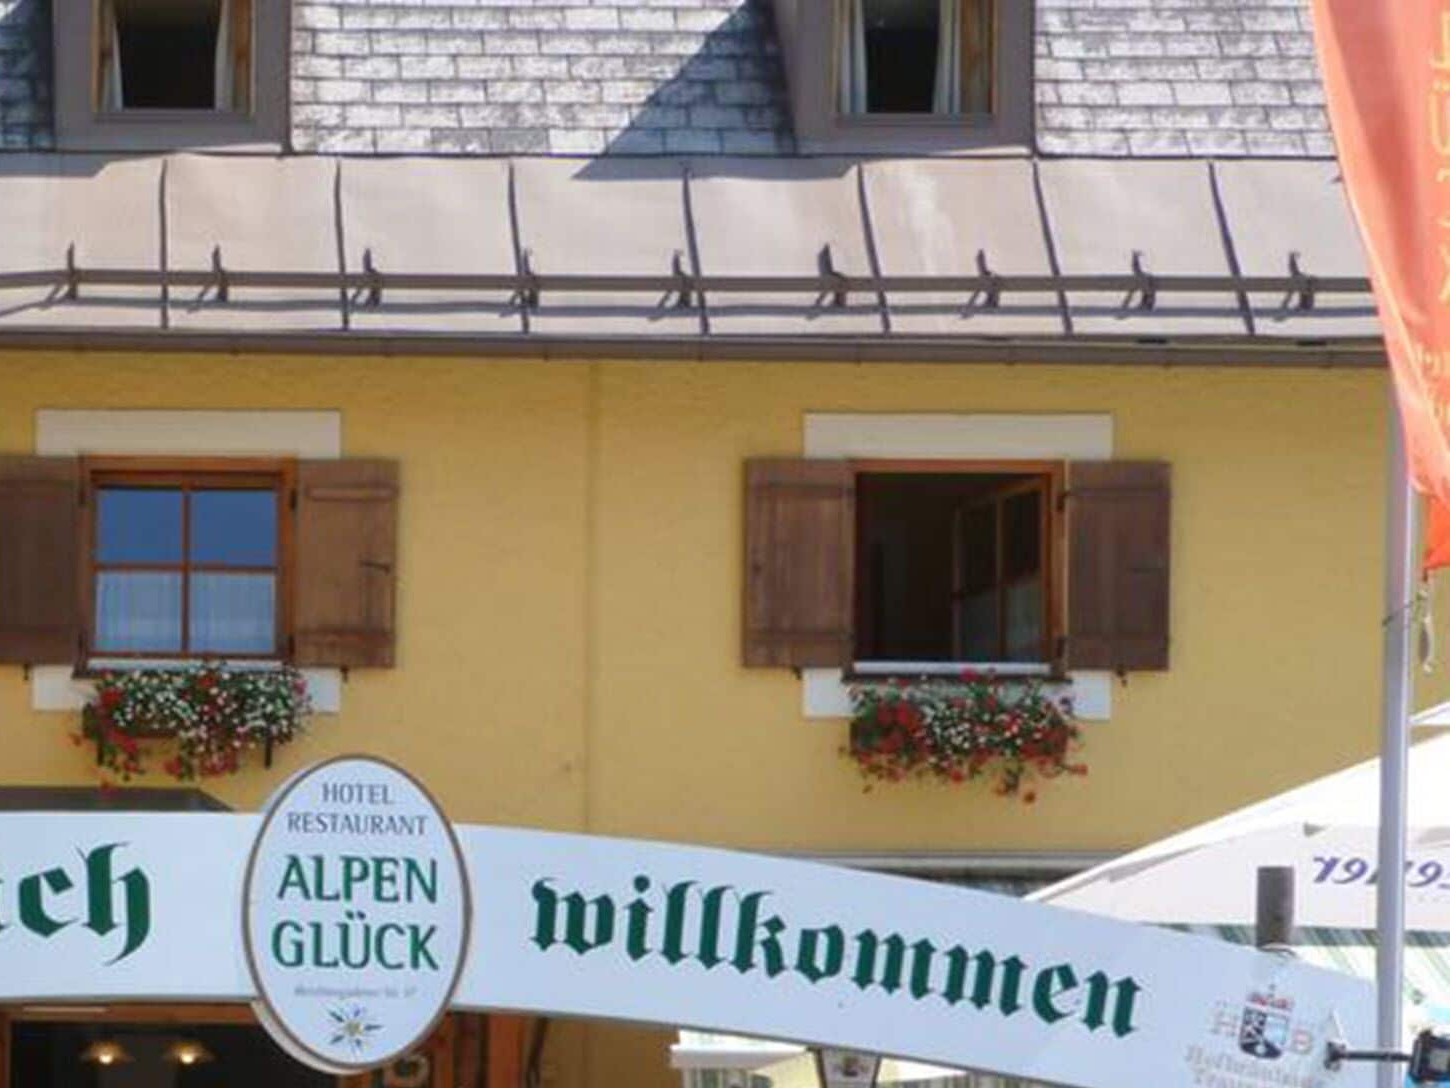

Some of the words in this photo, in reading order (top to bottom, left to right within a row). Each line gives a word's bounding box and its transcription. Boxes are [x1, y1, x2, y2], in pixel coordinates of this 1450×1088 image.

[321, 782, 395, 805] HOTEL
[286, 811, 429, 836] RESTAURANT
[276, 853, 439, 904] ALPEN
[270, 909, 440, 972] GLÜCK
[529, 874, 1142, 1039] willkommen
